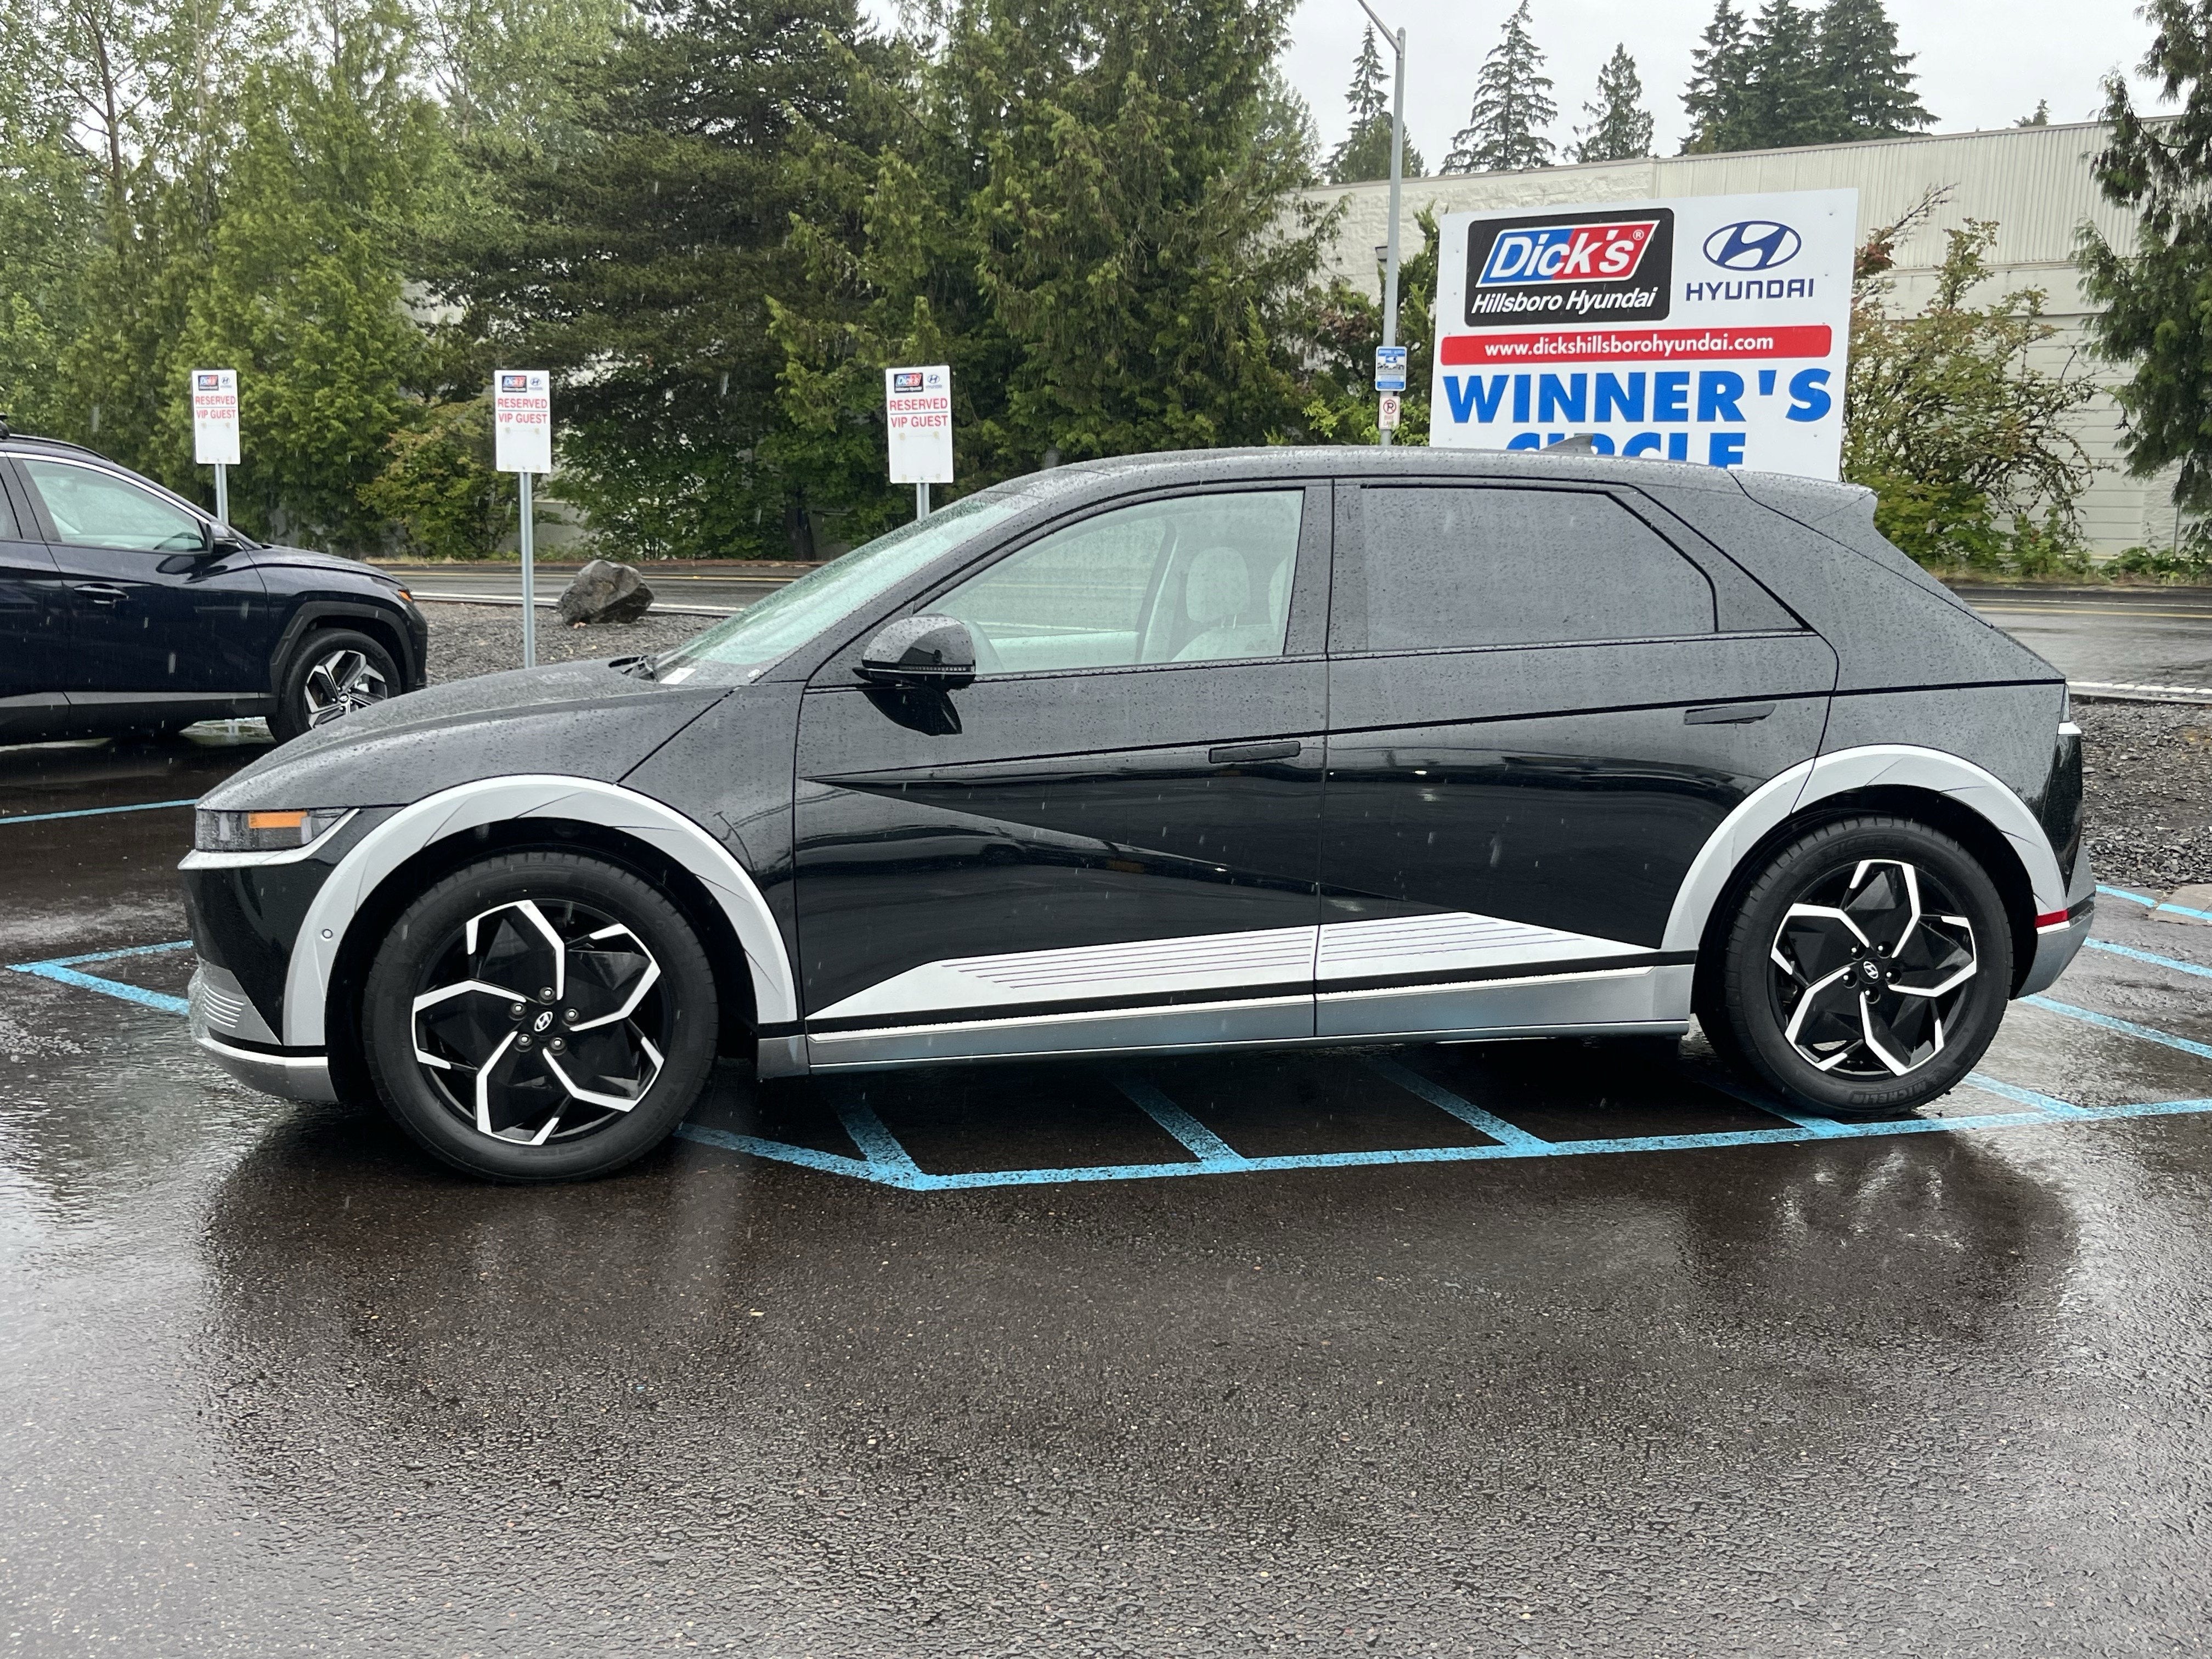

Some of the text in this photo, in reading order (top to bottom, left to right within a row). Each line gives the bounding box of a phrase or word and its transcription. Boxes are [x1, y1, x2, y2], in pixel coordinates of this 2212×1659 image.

[1685, 278, 1814, 301] HYUNDAI
[1471, 287, 1658, 315] Hillsboro Hyundai
[1485, 332, 1774, 358] www.dickshillsborohyundai.com
[195, 396, 236, 405] RESERVED
[1443, 368, 1832, 424] WINNER'S
[498, 398, 548, 409] RESERVED
[889, 398, 948, 411] RESERVED
[196, 409, 236, 419] VIP GUEST
[498, 413, 548, 424] VIP GUEST
[890, 415, 949, 428] VIP GUEST
